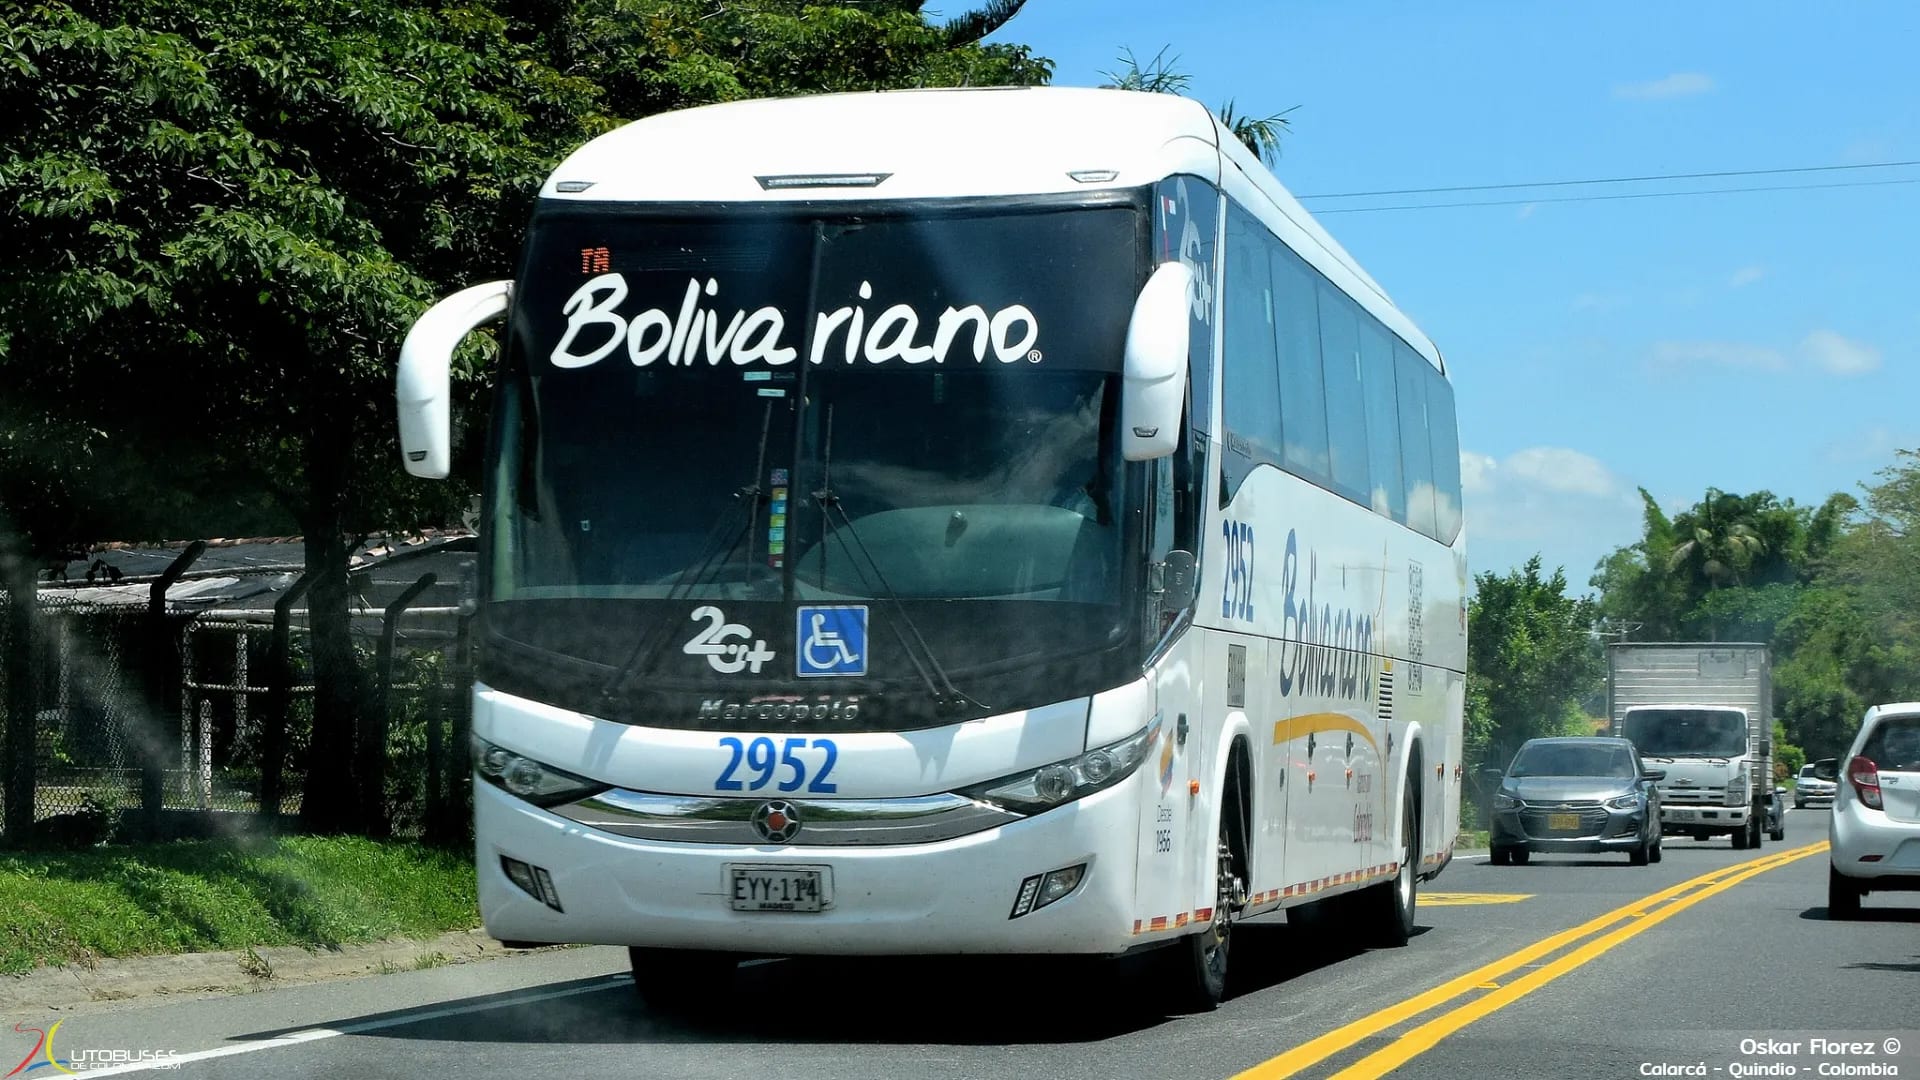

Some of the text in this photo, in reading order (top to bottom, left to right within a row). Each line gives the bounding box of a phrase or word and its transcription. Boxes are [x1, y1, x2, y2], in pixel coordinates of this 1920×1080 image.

[1222, 518, 1254, 622] 2952
[1279, 528, 1373, 702] Bolivariano
[697, 698, 861, 723] Marcopolo
[715, 736, 838, 794] 2952
[1156, 829, 1171, 853] 1956
